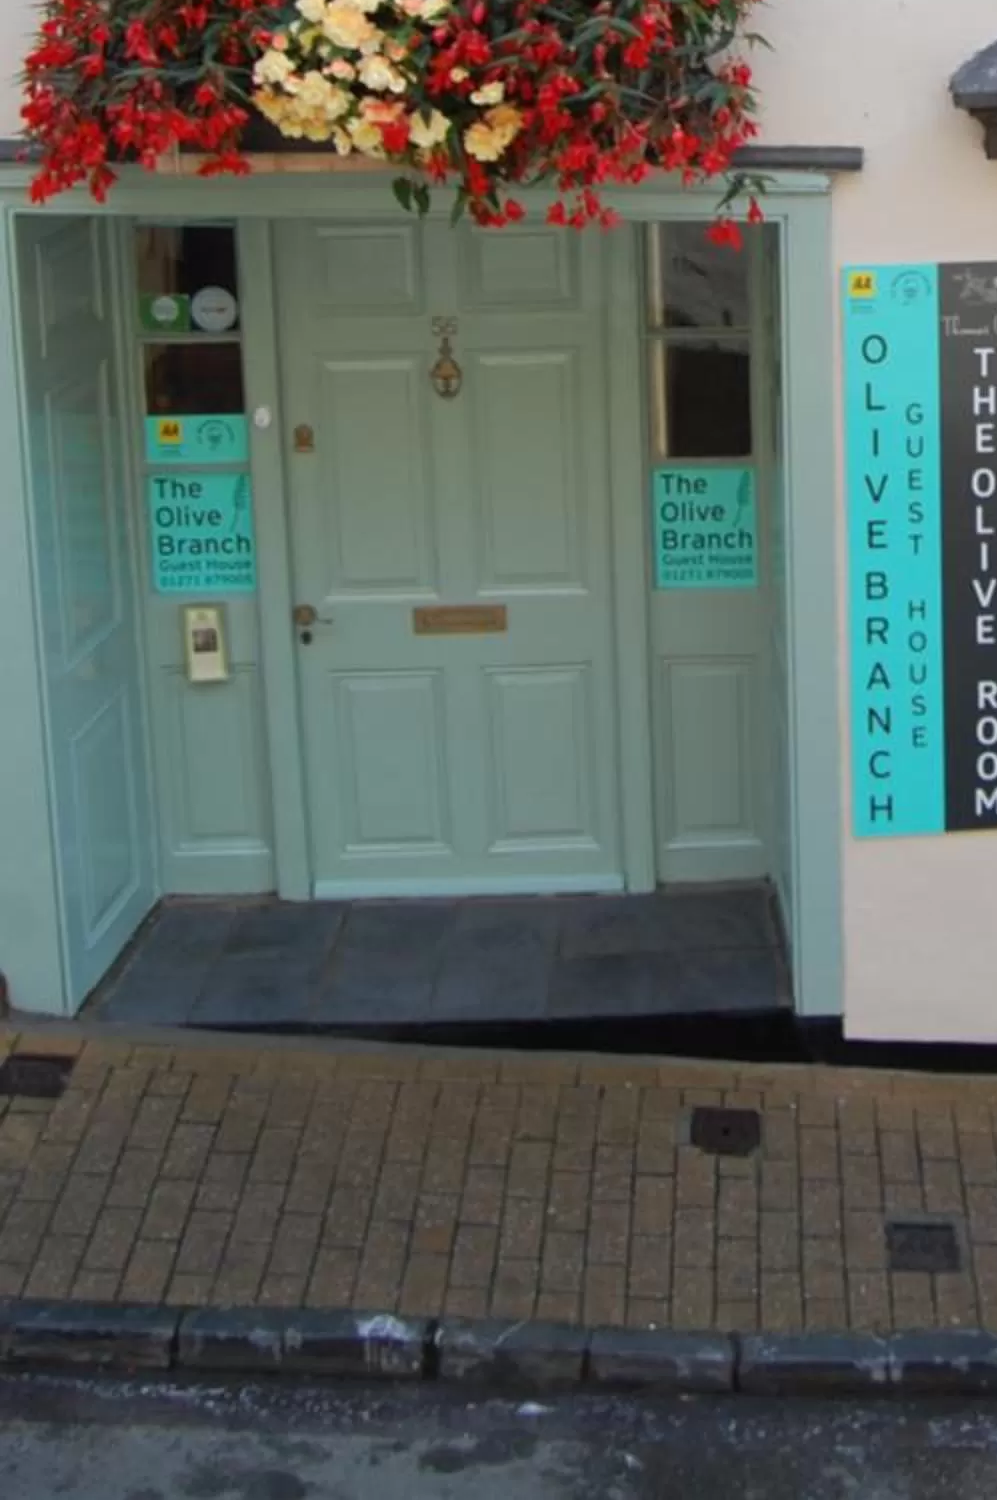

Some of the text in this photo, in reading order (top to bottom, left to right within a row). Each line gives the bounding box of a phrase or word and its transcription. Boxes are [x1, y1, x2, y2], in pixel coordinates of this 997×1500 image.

[972, 347, 996, 453] THE
[862, 333, 889, 550] OLIVE
[153, 478, 203, 499] The
[660, 473, 708, 496] The
[156, 506, 222, 528] Olive
[660, 501, 726, 522] Olive
[158, 535, 251, 556] Branch
[662, 528, 753, 550] Branch
[972, 467, 997, 644] OLIVE
[905, 402, 929, 750] GUEST HOUSE
[865, 570, 894, 824] BRANCH
